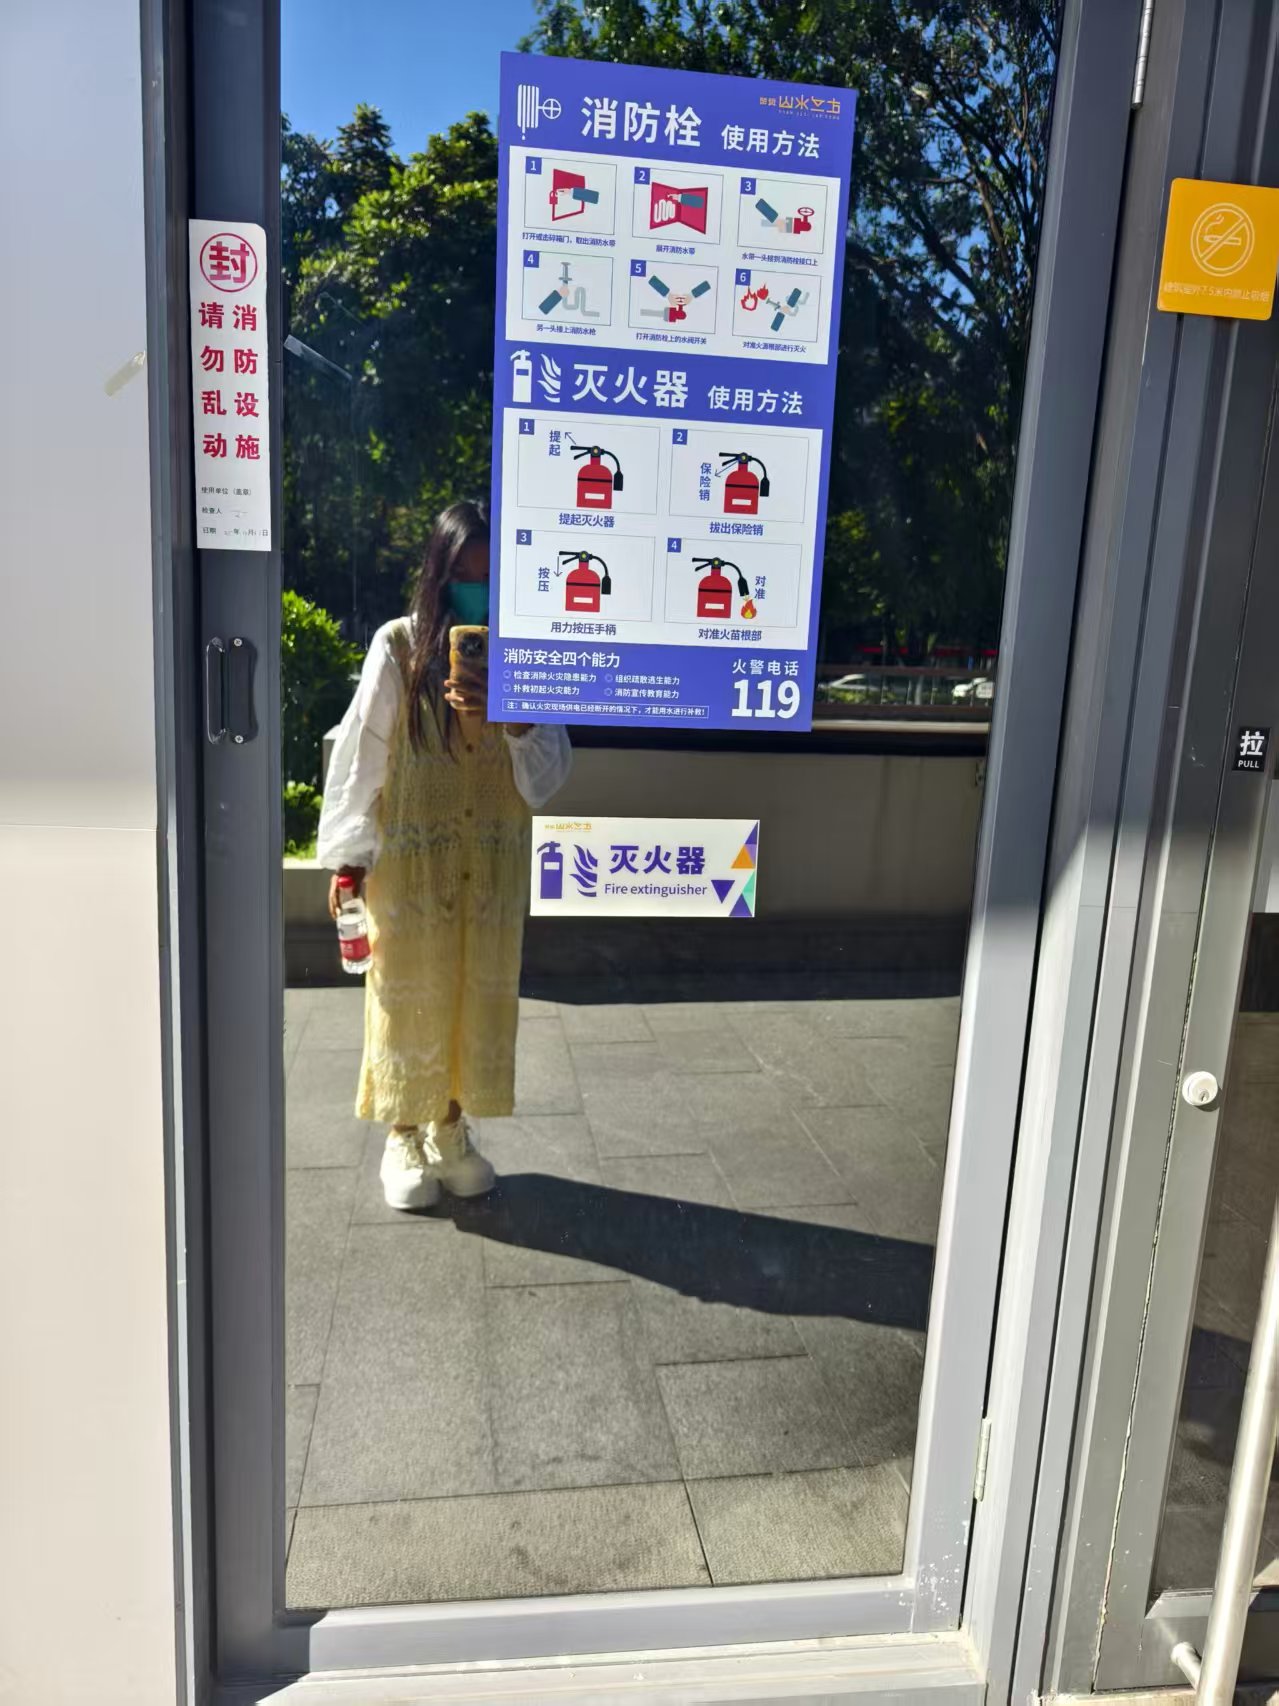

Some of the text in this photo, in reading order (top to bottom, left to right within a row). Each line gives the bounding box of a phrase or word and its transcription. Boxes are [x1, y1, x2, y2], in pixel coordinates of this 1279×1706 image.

[580, 96, 702, 148] 消防栓
[720, 124, 820, 159] 使用方法
[530, 160, 538, 172] 1
[639, 170, 647, 182] 2
[743, 180, 752, 192] 3
[655, 243, 696, 256] 展开消防水带
[209, 240, 251, 285] 封
[527, 253, 535, 265] 4
[634, 262, 642, 274] 5
[739, 271, 747, 283] 6
[536, 323, 597, 337] 另一头接上消防水枪
[635, 332, 708, 346] 打开消防栓上的水阀开关
[742, 341, 808, 354] 对准火源根部进行灭火
[198, 302, 227, 460] 请勿乱动
[232, 304, 261, 461] 消防设施
[571, 363, 690, 409] 灭火器
[708, 384, 804, 416] 使用方法
[523, 422, 531, 432] 1
[548, 430, 561, 457] 提起
[676, 432, 683, 442] 2
[698, 462, 712, 502] 保险销
[558, 512, 615, 529] 提起灭火器
[709, 521, 764, 536] 拔出保险销
[520, 531, 528, 543] 3
[671, 539, 678, 551] 4
[537, 567, 550, 593] 按压
[754, 575, 767, 600] 对准
[550, 620, 617, 637] 用力按压手柄
[698, 627, 762, 643] 对准火苗根部
[503, 648, 621, 668] 消防安全四个能力
[732, 659, 800, 677] 火警电话
[513, 670, 597, 683] 检查消除火灾隐患能力
[614, 673, 681, 686] 组织疏散逃生能力
[513, 683, 581, 696] 扑救初起火灾能力
[614, 687, 680, 700] 消防宣传教育能力
[731, 678, 801, 719] 119
[1240, 730, 1265, 756] 拉
[1238, 759, 1260, 769] PULL
[609, 845, 706, 876] 灭火器
[604, 883, 708, 898] Fire extinguisher
